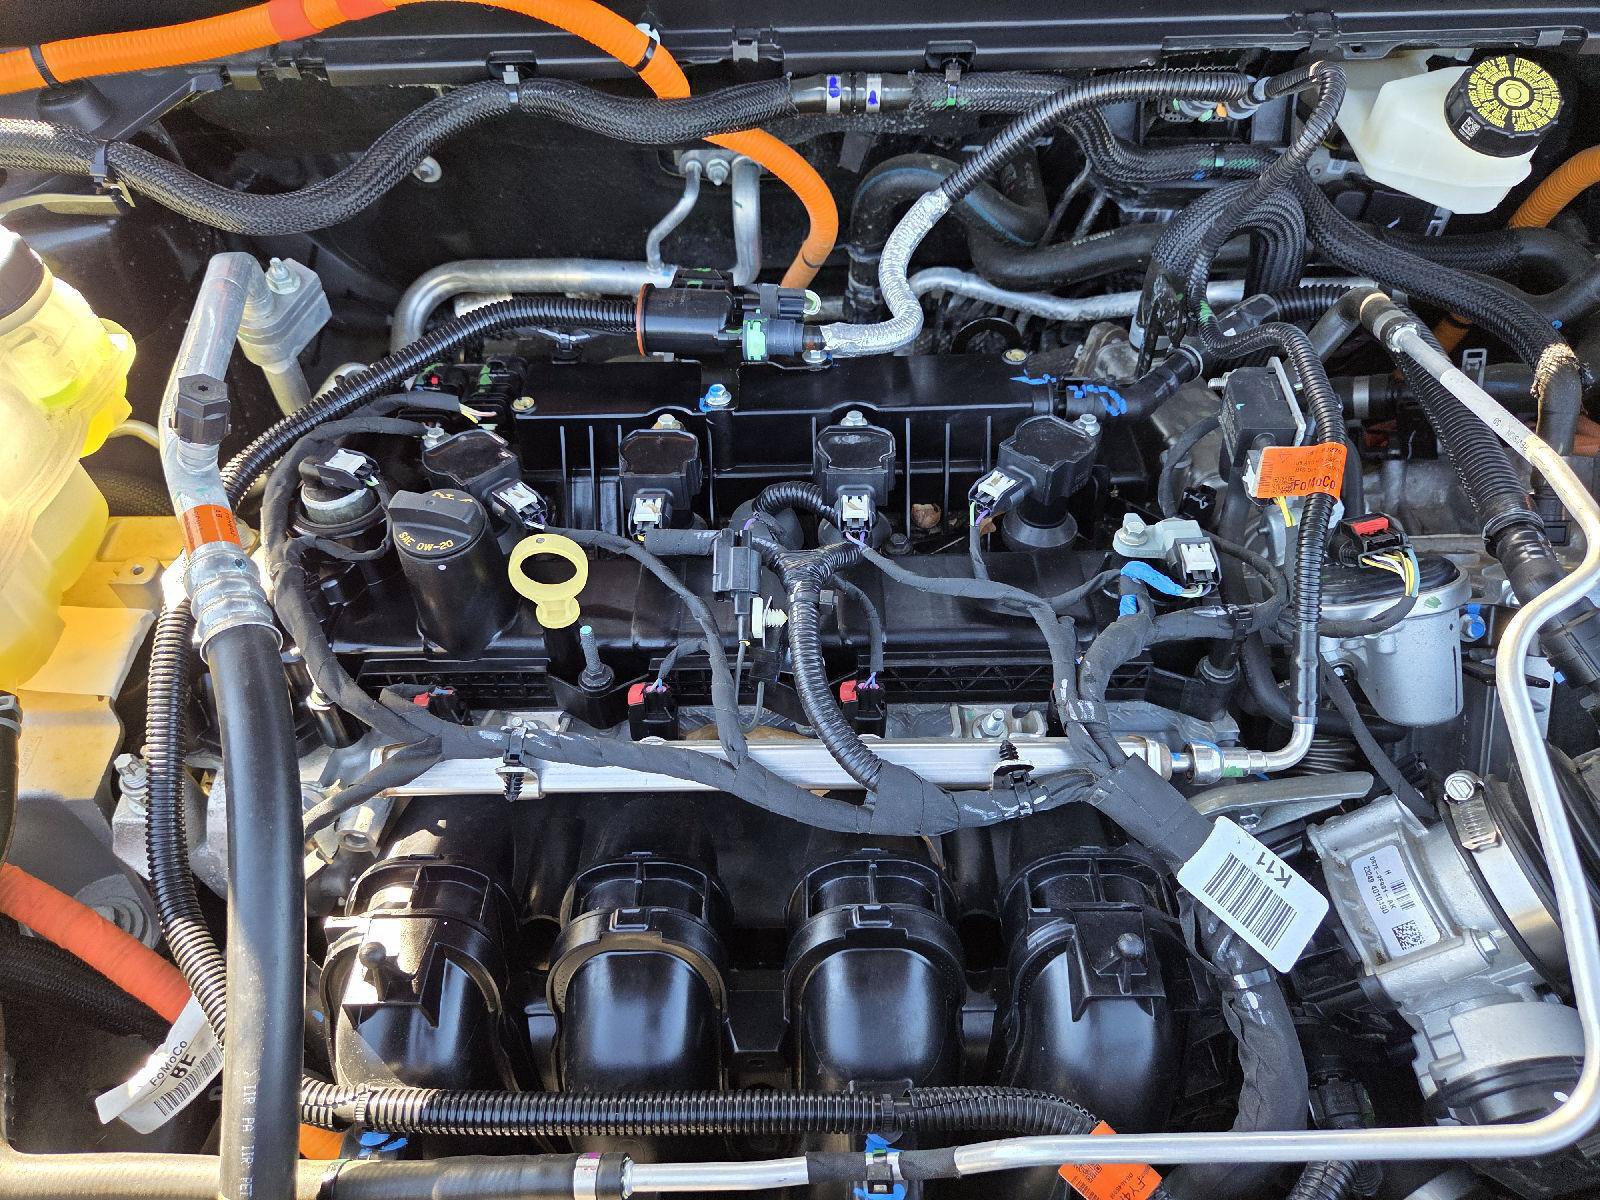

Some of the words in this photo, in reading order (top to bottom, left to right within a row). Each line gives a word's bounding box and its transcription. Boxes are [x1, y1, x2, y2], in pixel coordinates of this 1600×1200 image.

[398, 531, 416, 546] SAE
[1256, 851, 1292, 889] K11
[150, 1040, 188, 1087] FoMoCo
[170, 1053, 197, 1080] BE
